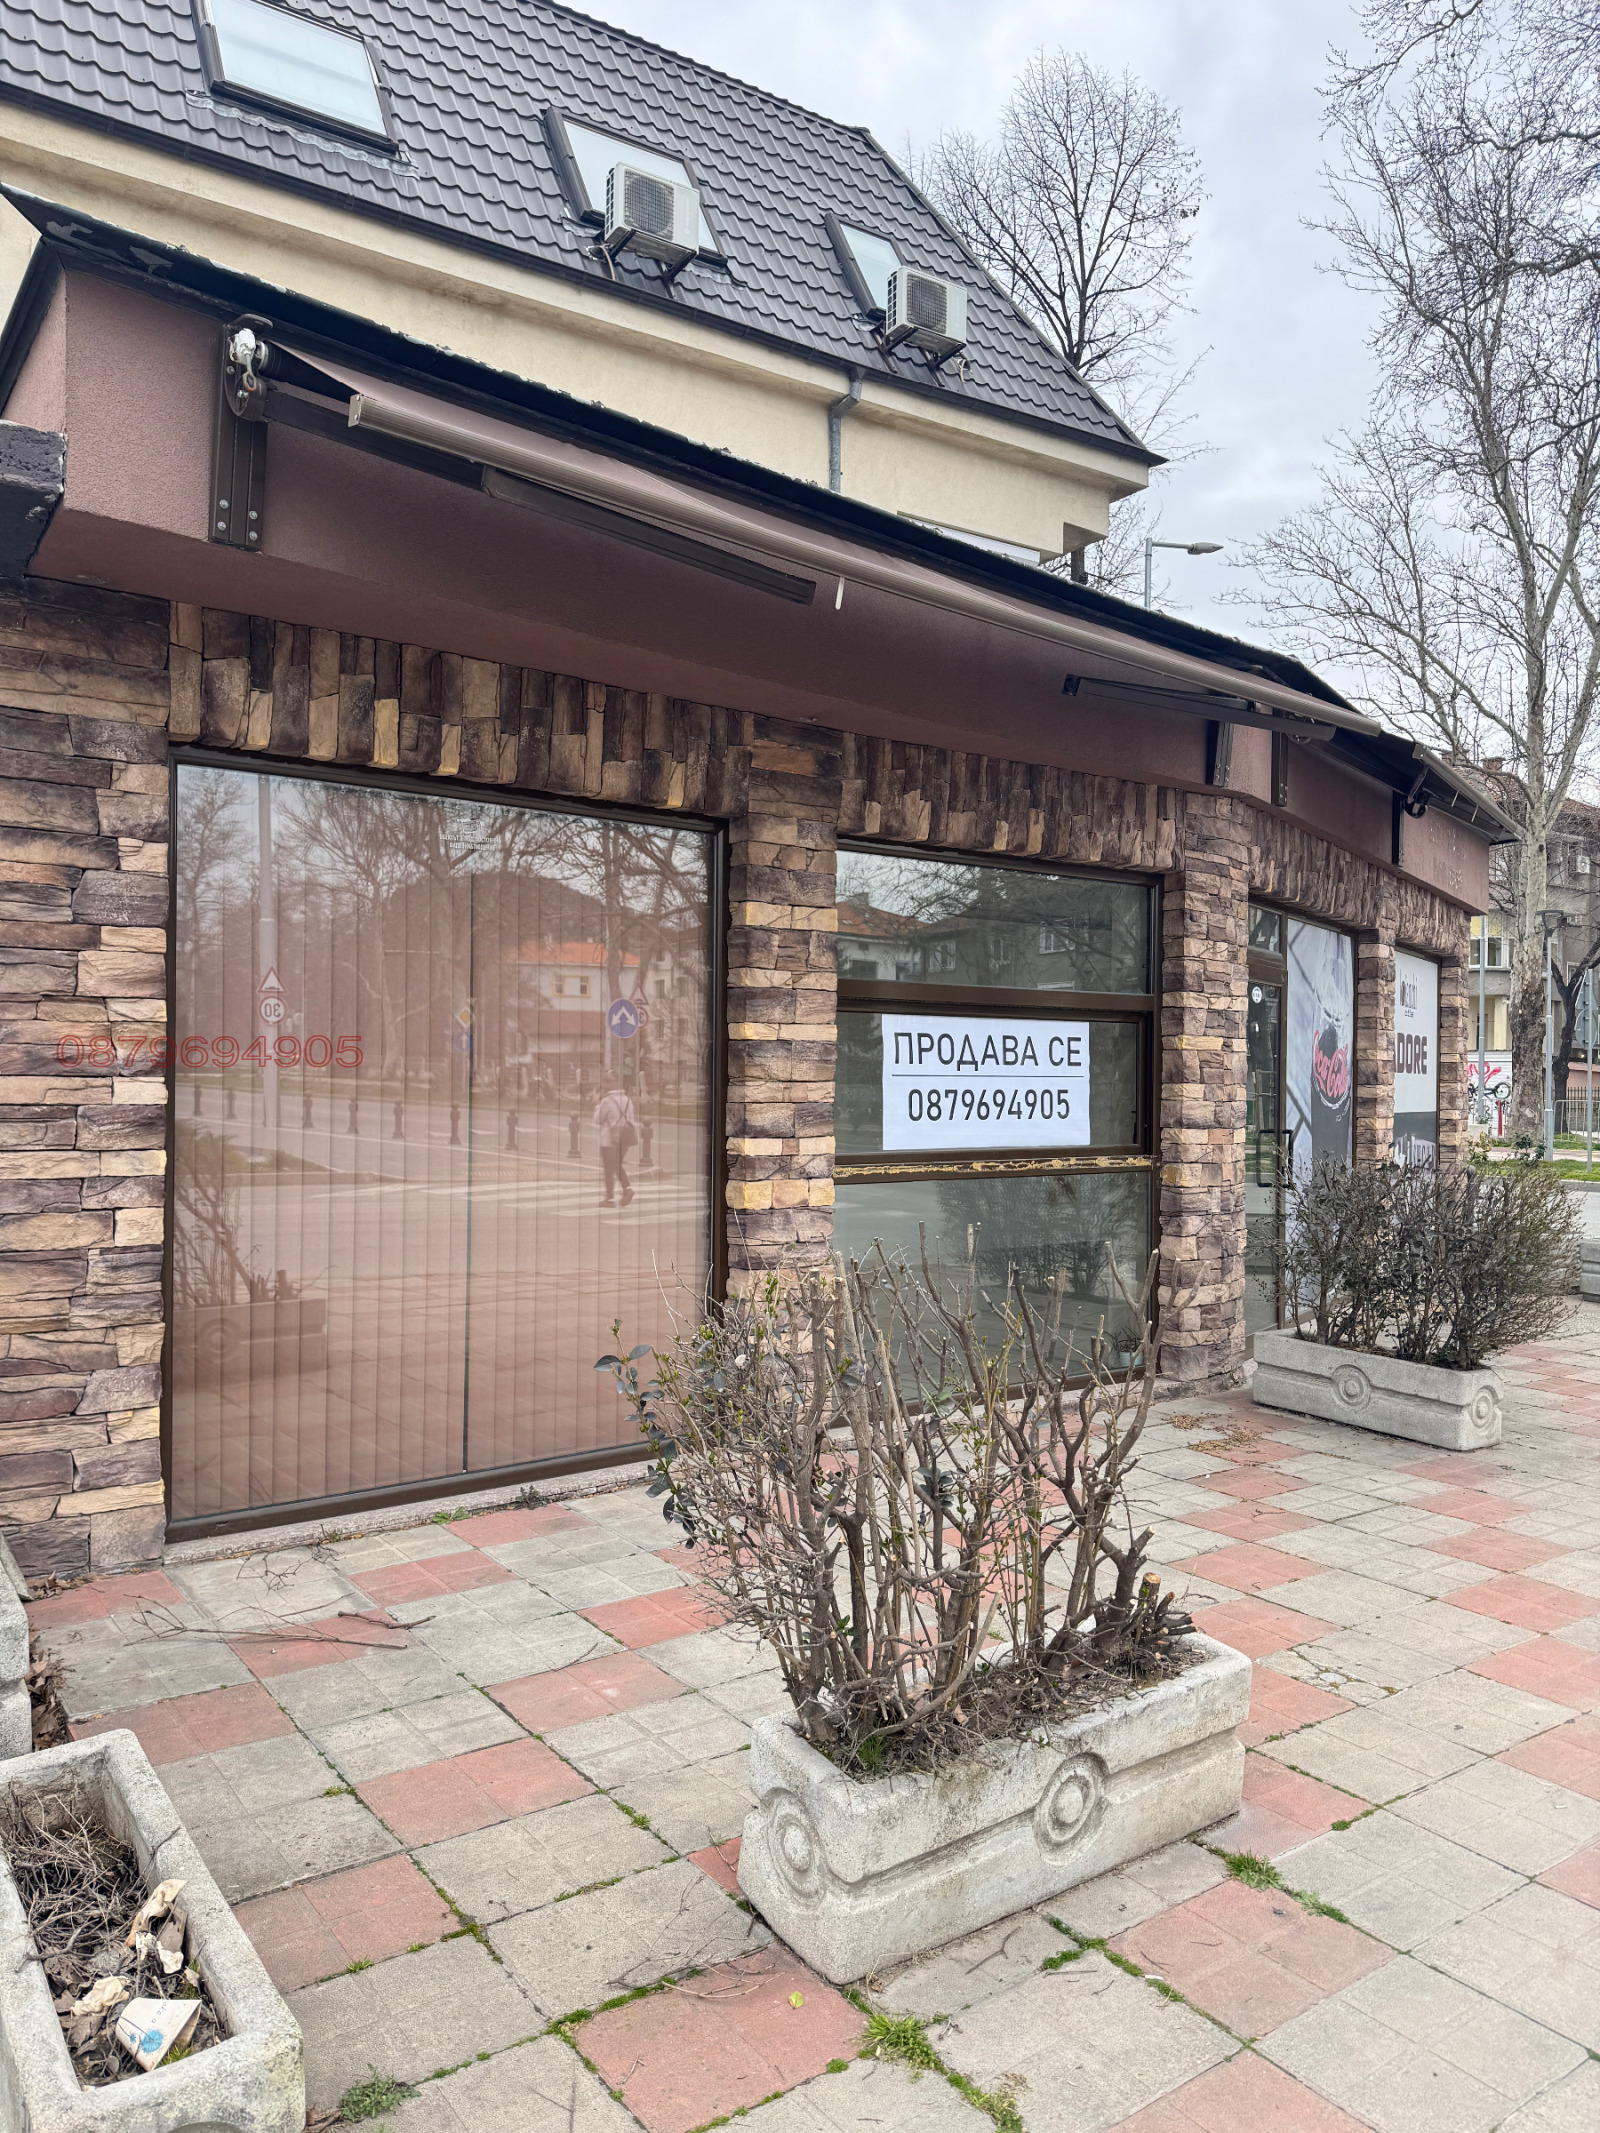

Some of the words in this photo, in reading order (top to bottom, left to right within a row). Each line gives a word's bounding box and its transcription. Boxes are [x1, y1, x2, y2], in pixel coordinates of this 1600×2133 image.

[894, 1032, 1039, 1072] ПРОДАВА
[1049, 1036, 1082, 1067] СЕ
[908, 1088, 1070, 1122] 0879694905
